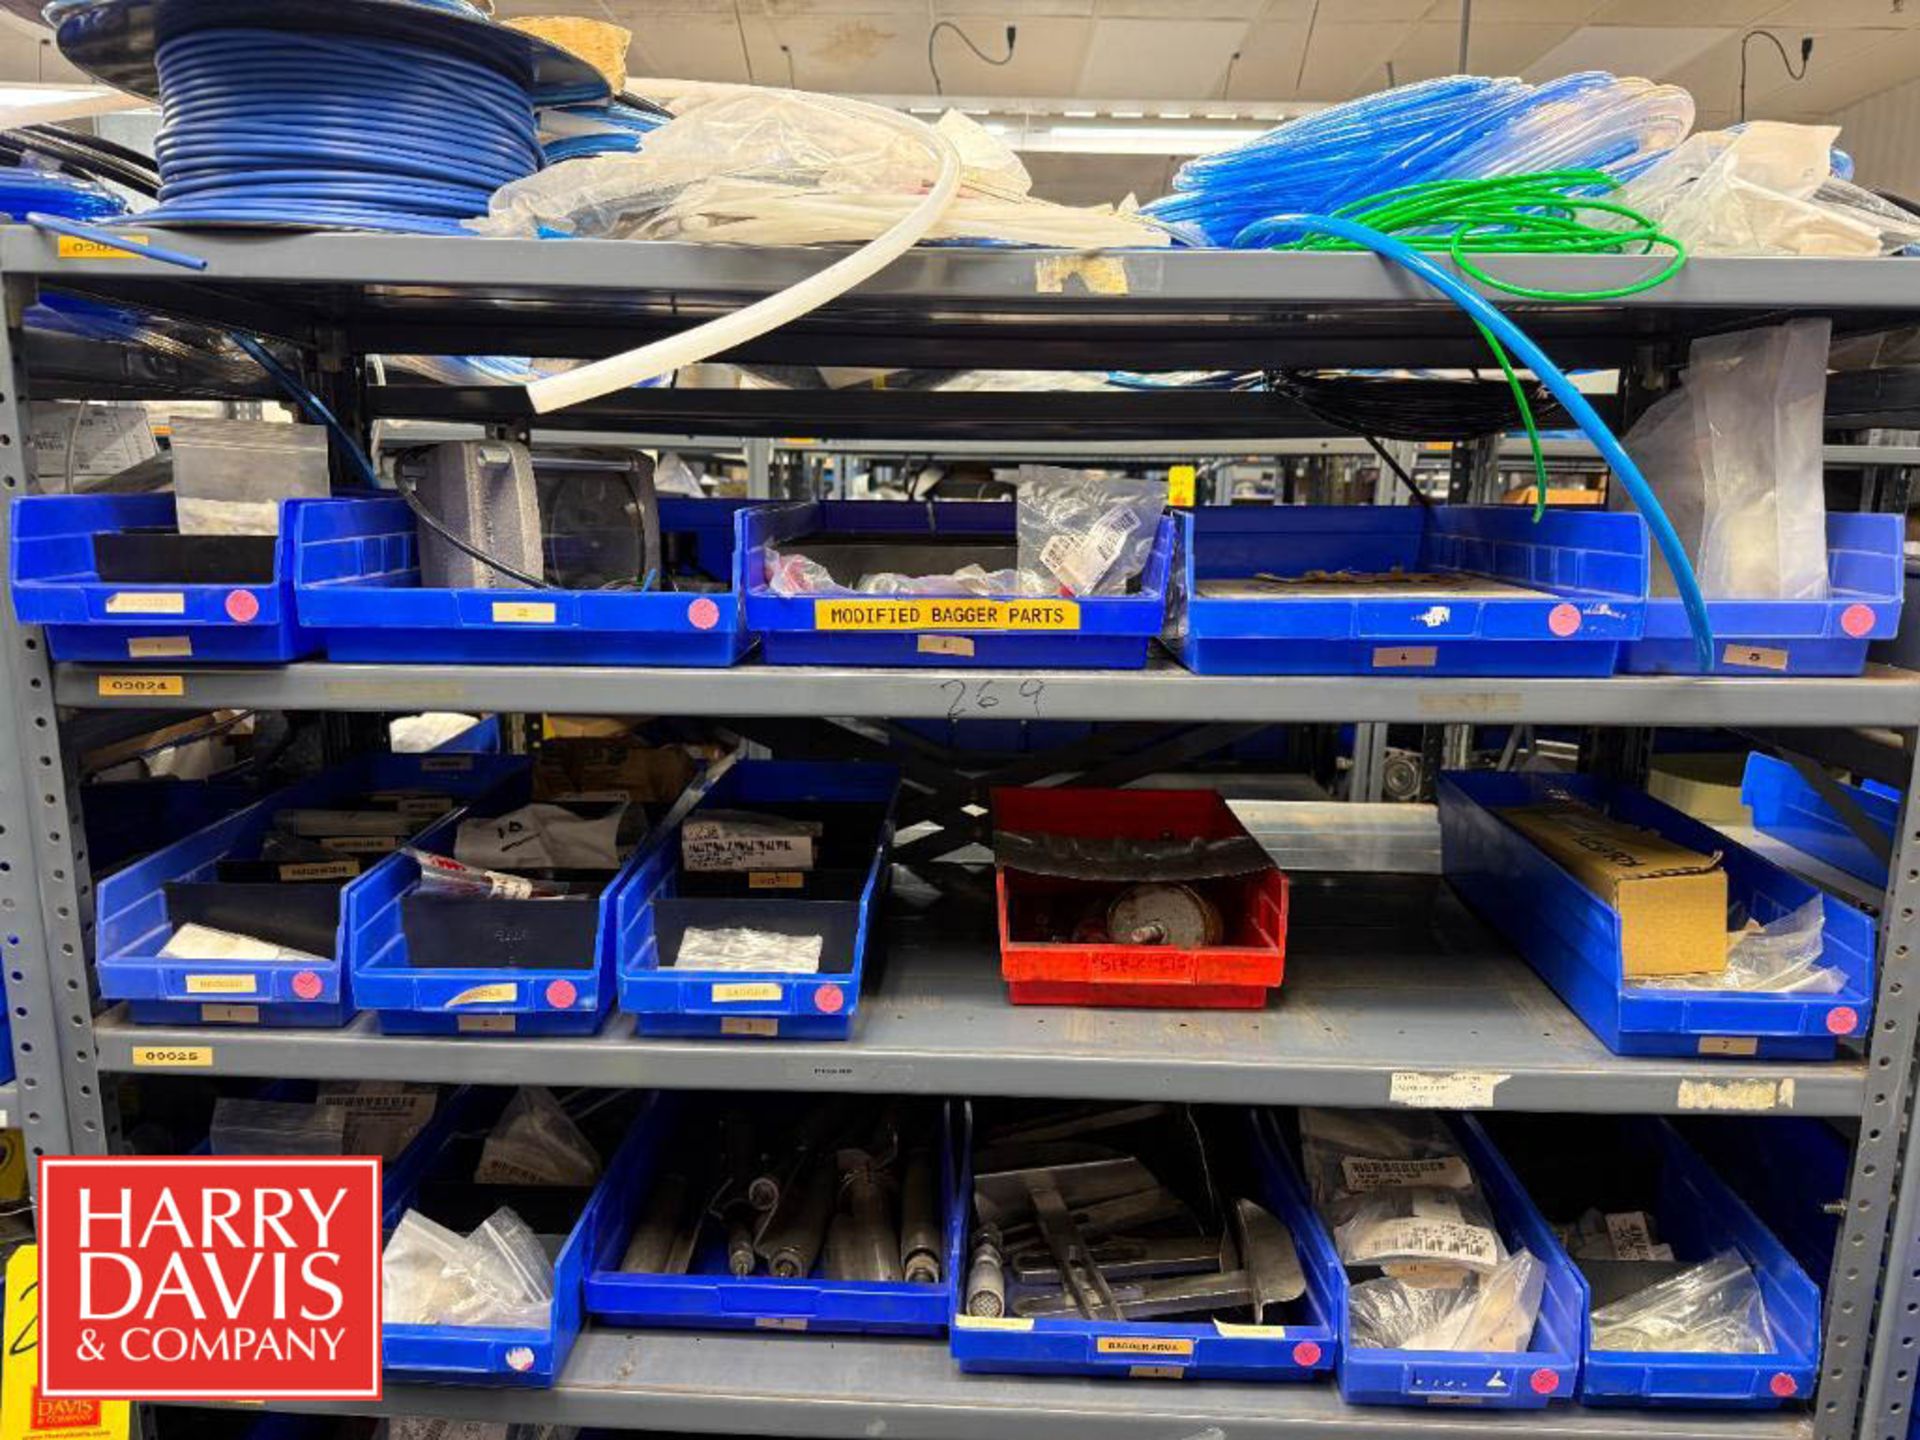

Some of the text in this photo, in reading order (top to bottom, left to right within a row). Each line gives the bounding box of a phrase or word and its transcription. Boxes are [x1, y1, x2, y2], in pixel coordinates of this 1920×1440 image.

[831, 607, 1065, 624] MODIFIED BAGGER PARTS
[38, 1400, 94, 1417] DAVIS
